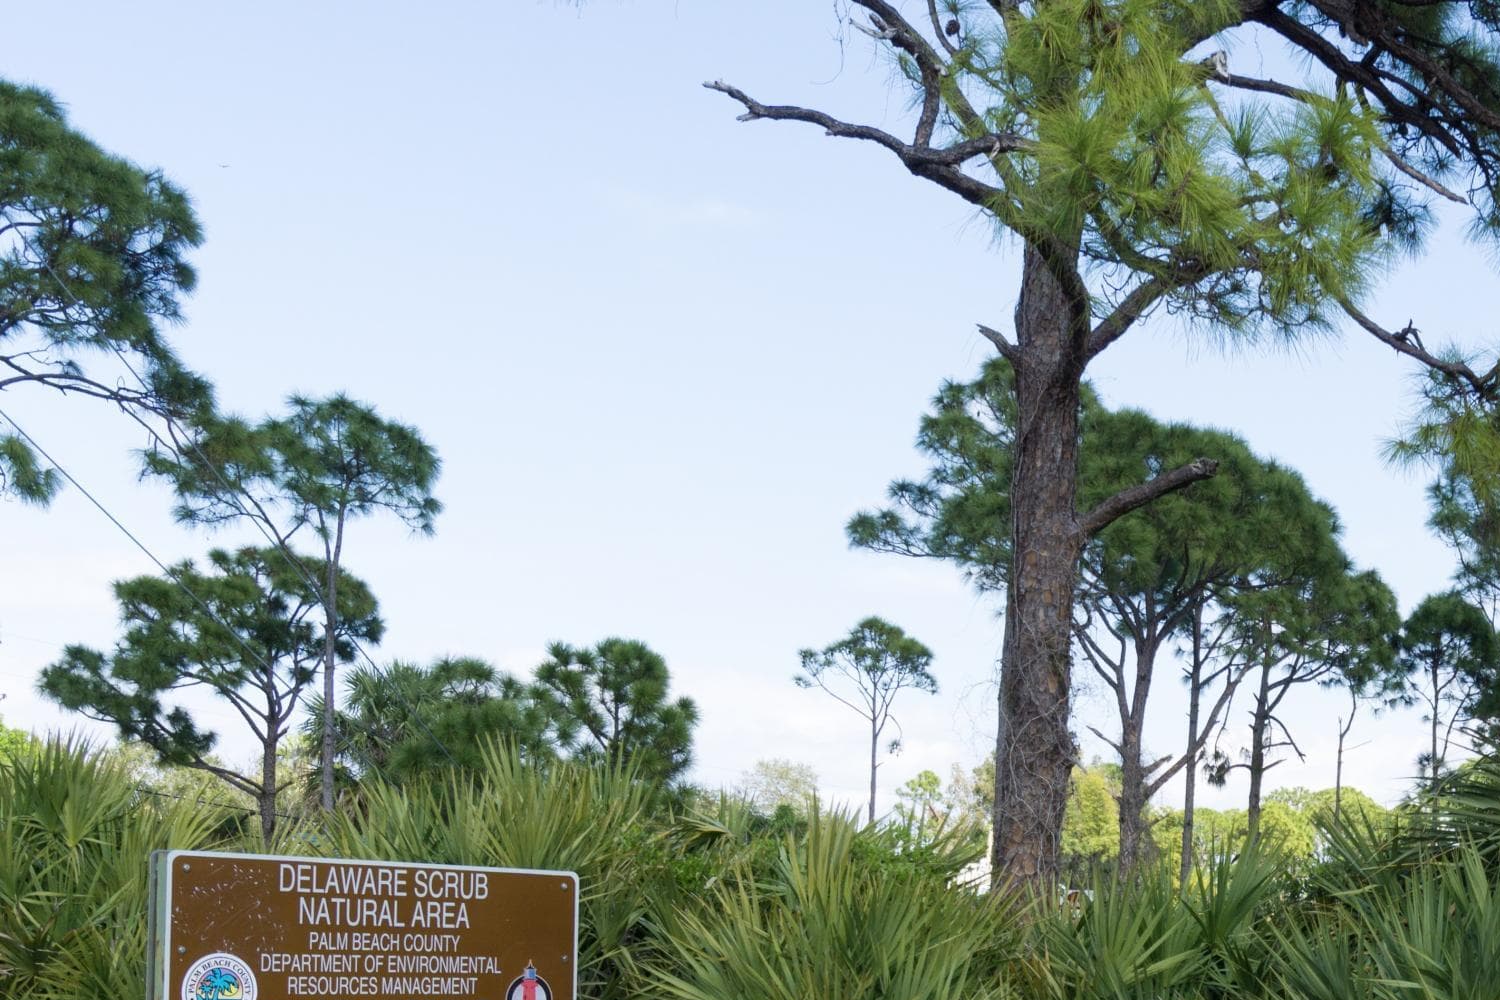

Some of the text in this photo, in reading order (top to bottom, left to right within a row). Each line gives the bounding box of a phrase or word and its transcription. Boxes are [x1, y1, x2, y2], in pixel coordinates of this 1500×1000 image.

[279, 864, 489, 899] DELAWARE SCRUB
[299, 897, 470, 929] NATURAL AREA
[309, 932, 460, 953] PALM BEACH COUNTY
[188, 959, 251, 994] PALM BEACH COUNTY
[261, 954, 501, 974] DEPARTMENT OF ENVIRONMENTAL
[288, 977, 478, 995] RESOURCES MANAGEMENT
